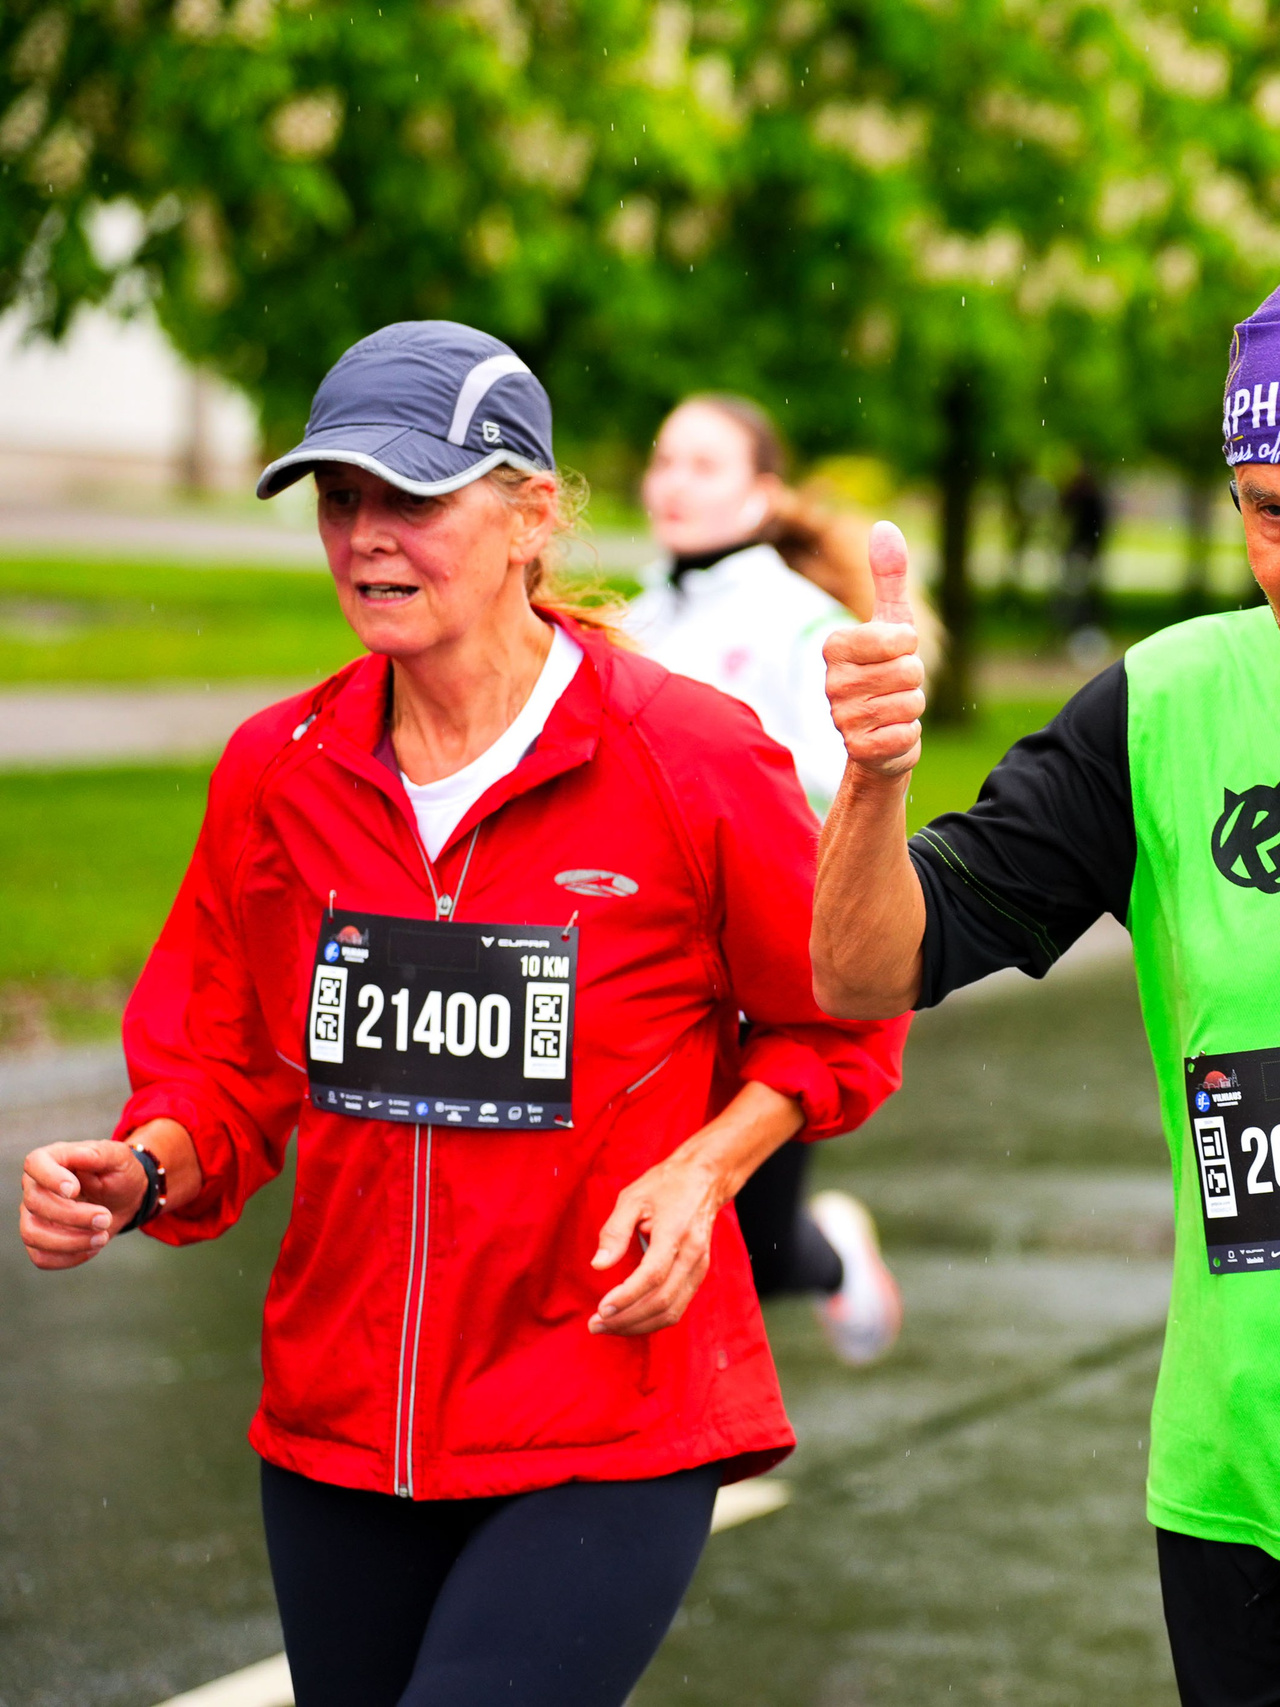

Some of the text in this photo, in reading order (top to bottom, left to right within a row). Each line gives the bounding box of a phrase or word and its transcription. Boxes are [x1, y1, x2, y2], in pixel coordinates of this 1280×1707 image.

[520, 954, 570, 979] 10 KM
[356, 984, 512, 1059] 21400
